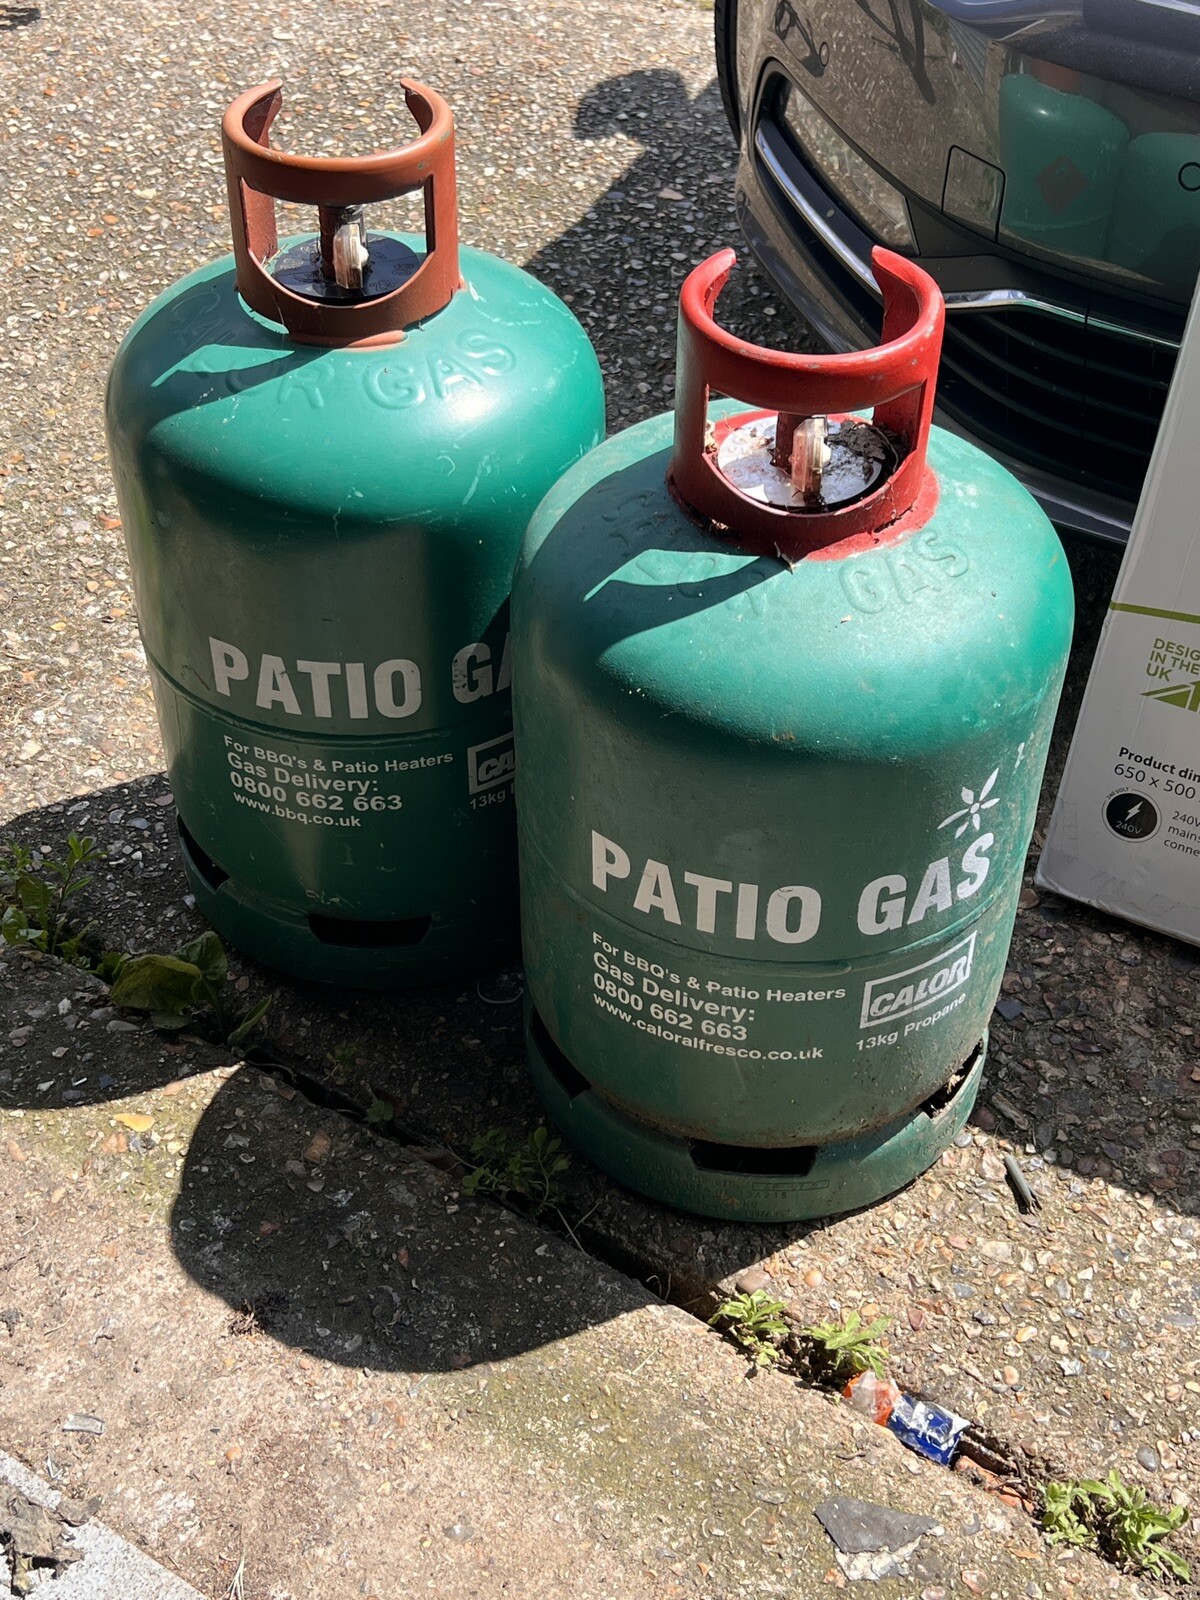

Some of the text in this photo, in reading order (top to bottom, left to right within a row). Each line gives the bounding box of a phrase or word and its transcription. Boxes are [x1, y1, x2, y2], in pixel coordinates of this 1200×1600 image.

[362, 328, 517, 410] GAS
[209, 636, 422, 719] PATIO
[1146, 663, 1173, 682] UK
[1149, 650, 1200, 675] IN THE
[224, 735, 453, 774] For BBQ's & Patio Heaters
[227, 751, 378, 796] Gas Delivery:
[1119, 746, 1176, 775] Product
[230, 772, 403, 811] 0800 662 663
[470, 787, 506, 811] 13kg
[1114, 763, 1196, 800] 650 x 500
[233, 791, 361, 827] www.bbq.co.uk
[1115, 820, 1143, 834] 240V
[592, 830, 994, 944] PATIO GAS
[593, 932, 846, 1001] For BBQ's & Patio Heaters
[593, 952, 755, 1023] Gas Delivery:
[869, 955, 969, 1017] CALOR
[593, 972, 748, 1040] 0800 662 663
[593, 993, 823, 1060] www.caloralfresco.co.uk
[856, 992, 966, 1051] 13kg Propane
